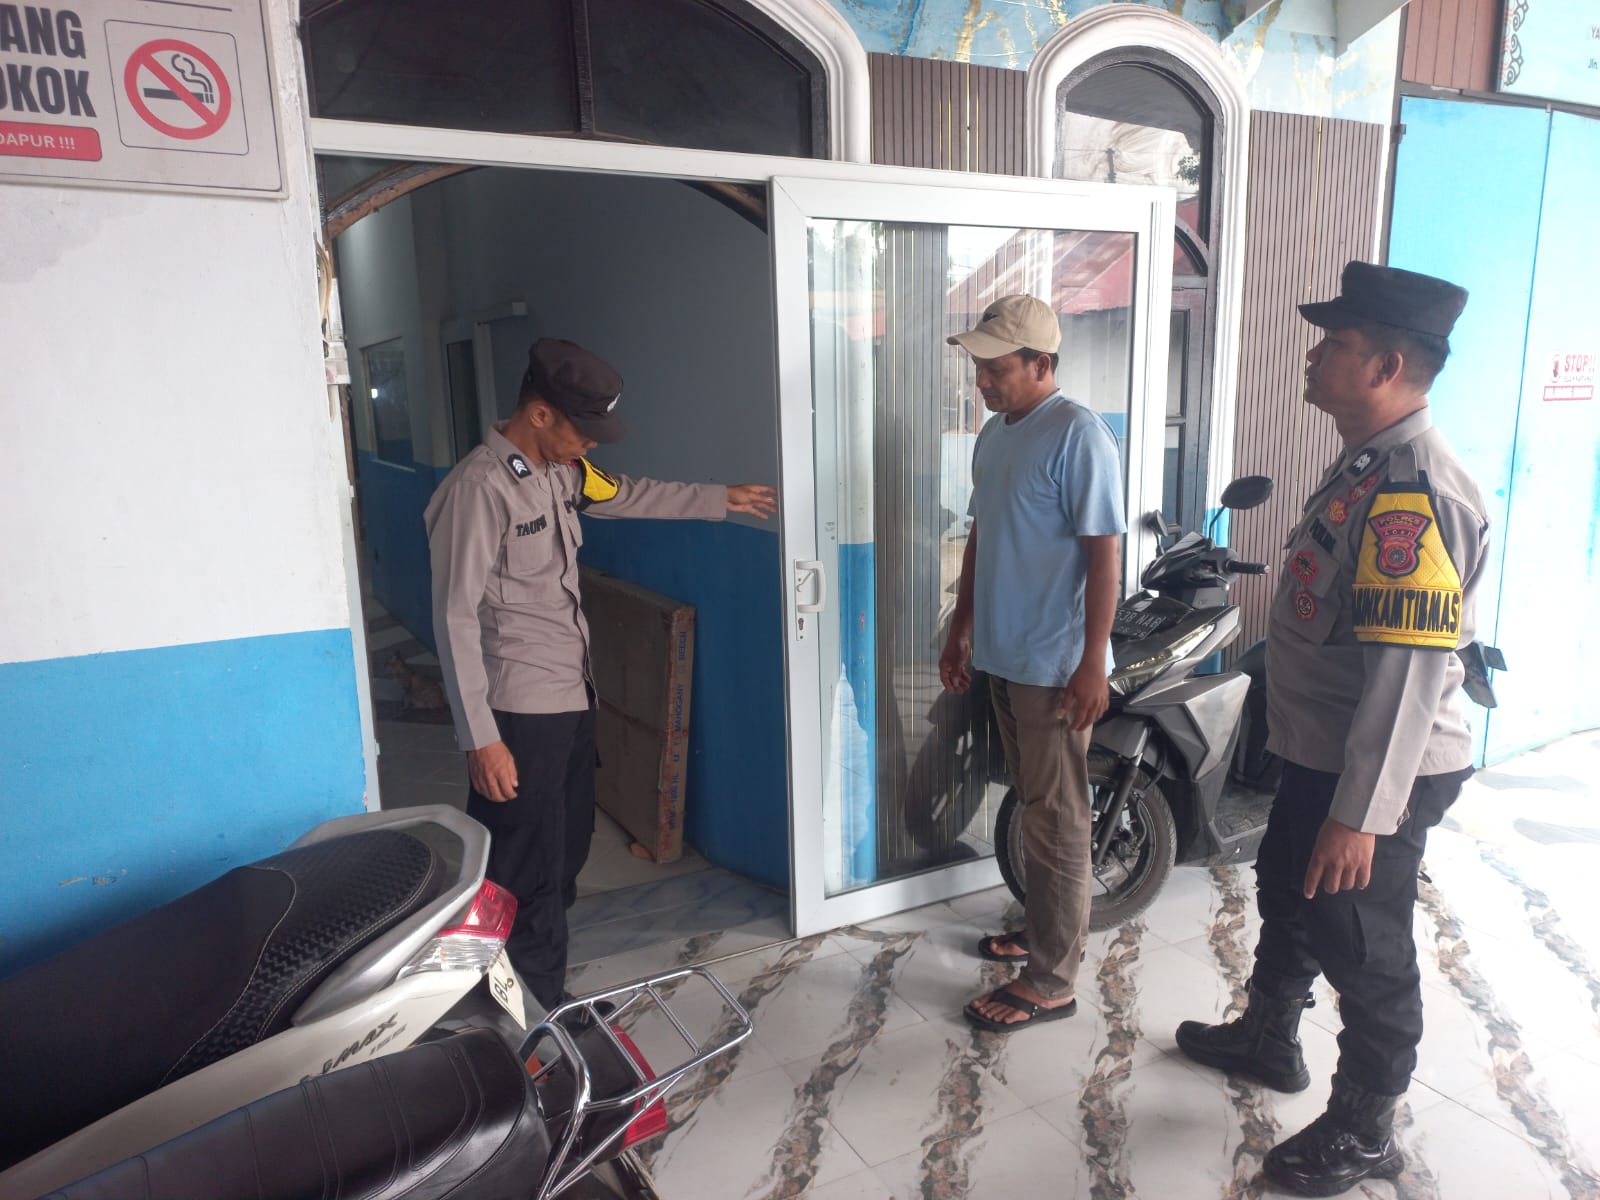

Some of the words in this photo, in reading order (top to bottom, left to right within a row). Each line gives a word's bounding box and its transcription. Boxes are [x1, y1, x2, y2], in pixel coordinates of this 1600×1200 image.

[0, 4, 87, 60] ANG
[0, 62, 97, 118] KOK
[493, 976, 509, 1004] BL
